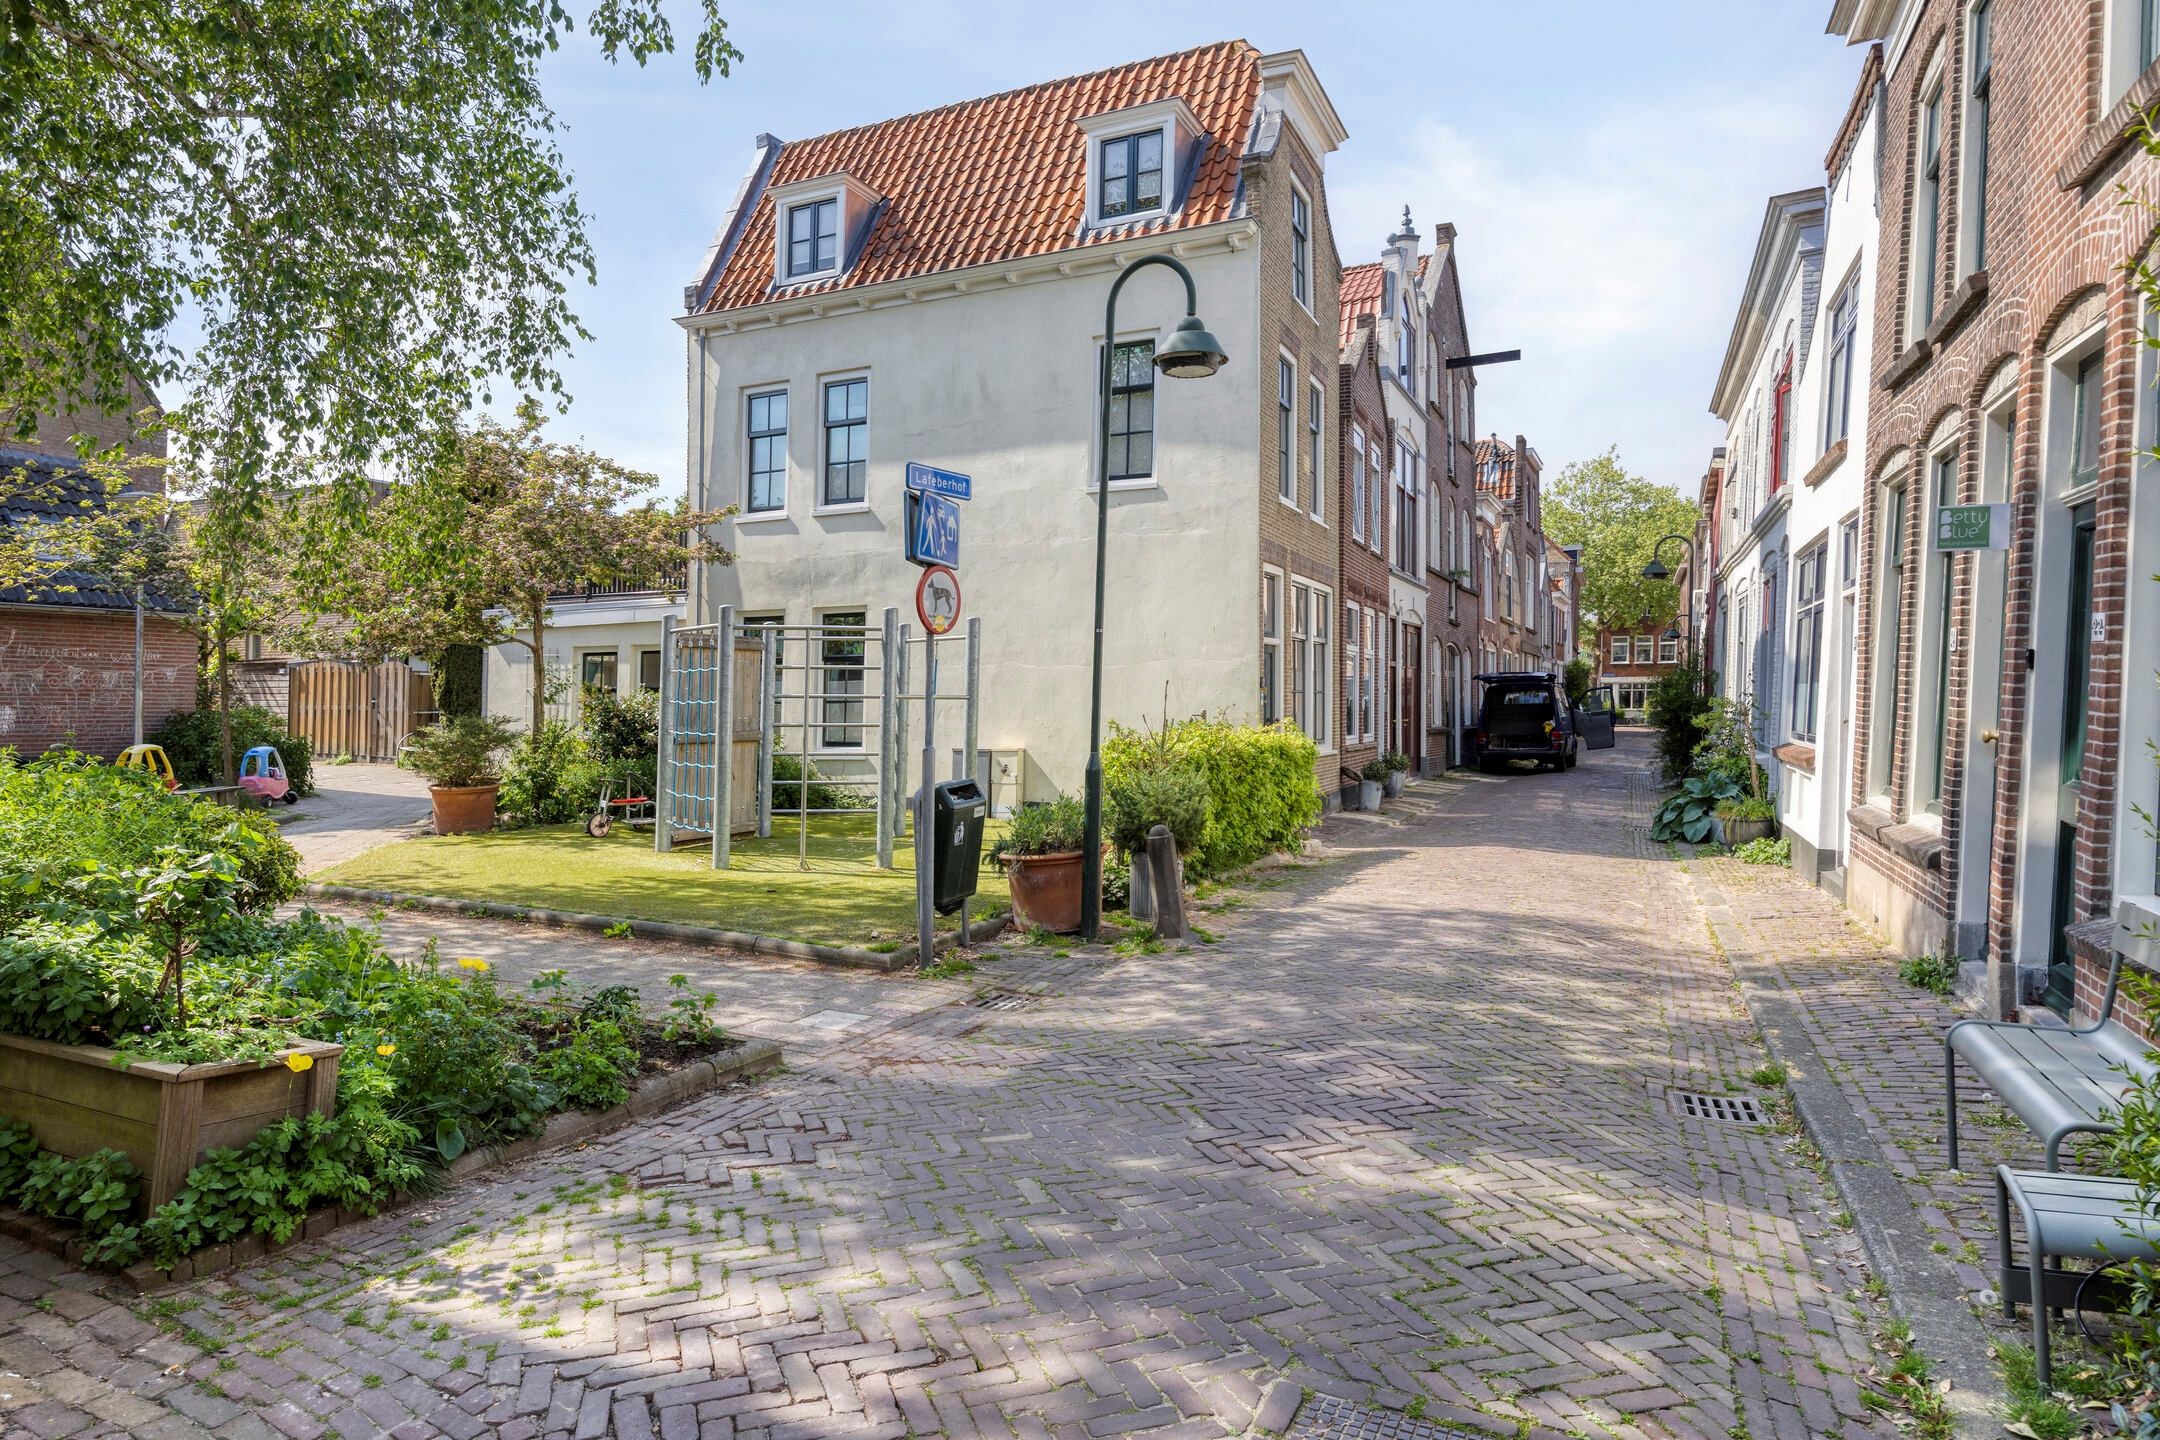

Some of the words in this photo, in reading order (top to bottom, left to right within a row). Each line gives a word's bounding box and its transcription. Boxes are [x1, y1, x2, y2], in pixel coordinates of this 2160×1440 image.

[915, 471, 967, 492] Lafeberhof
[1940, 510, 1988, 528] Betty
[1940, 524, 1979, 539] Blue
